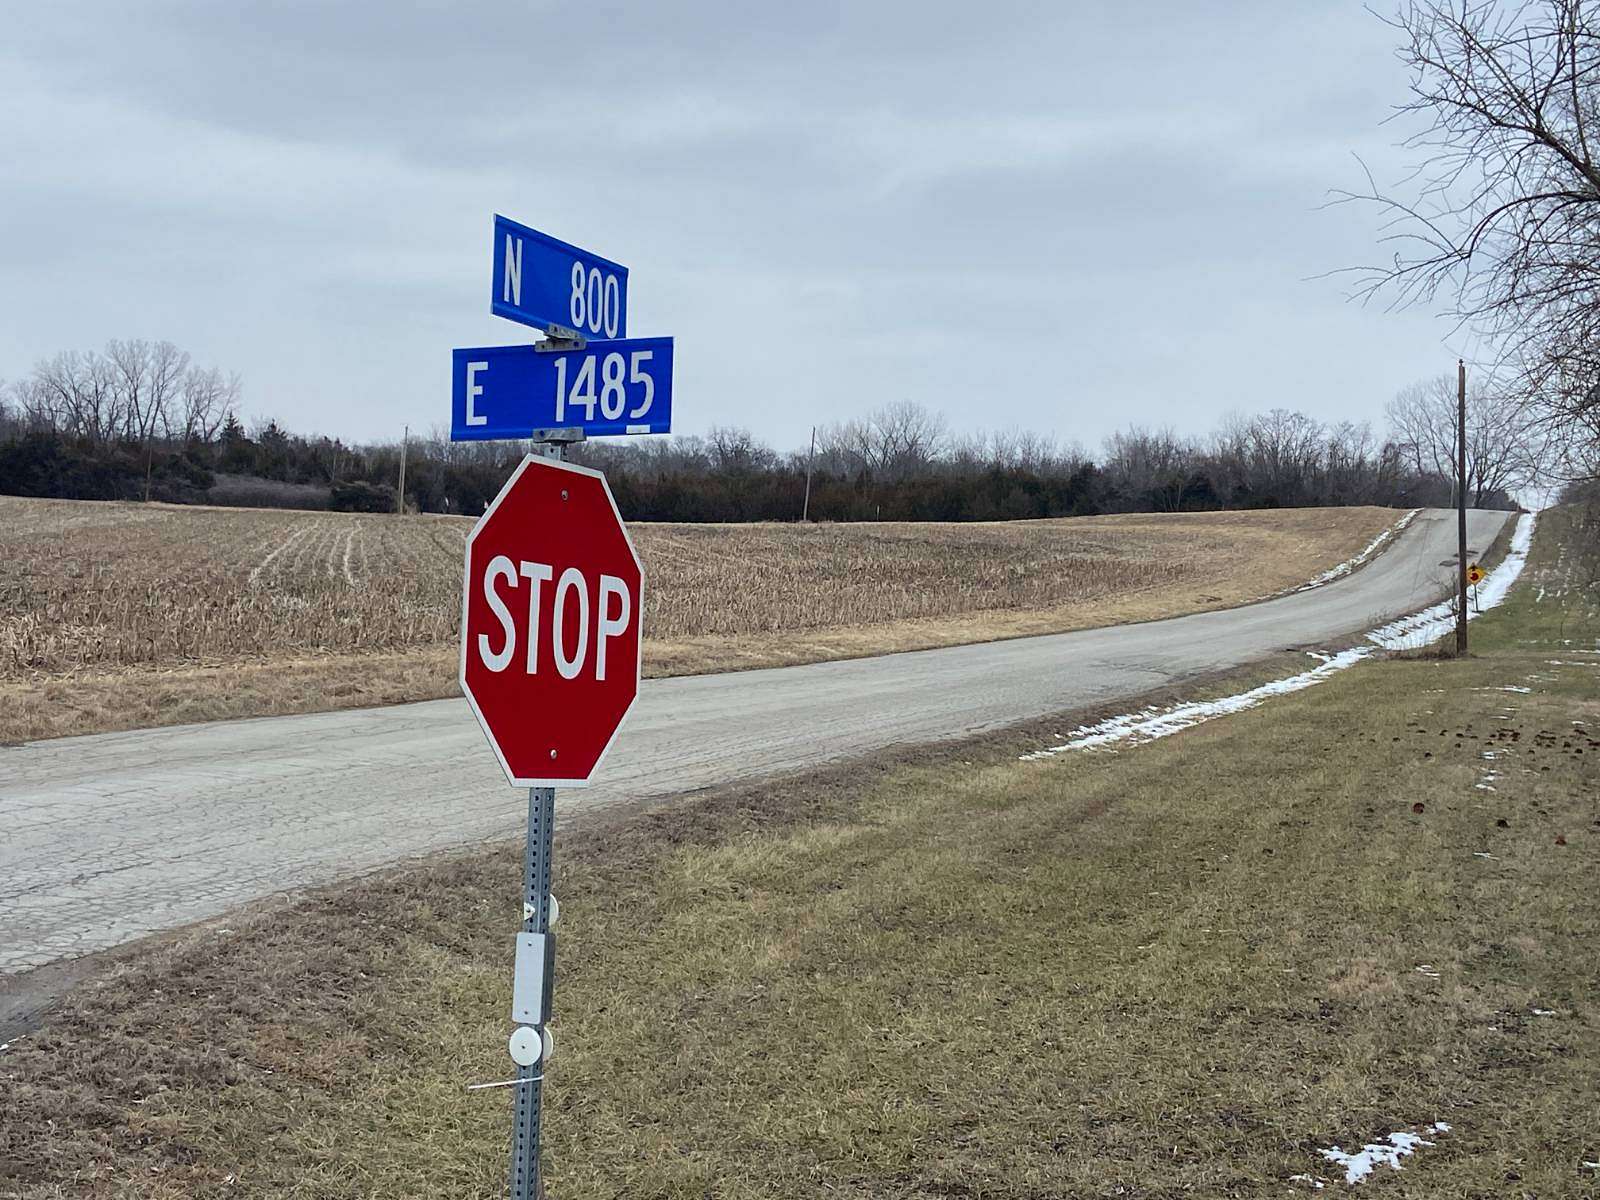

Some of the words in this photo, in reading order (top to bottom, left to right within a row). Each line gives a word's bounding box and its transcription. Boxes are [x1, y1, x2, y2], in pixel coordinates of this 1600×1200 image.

[503, 233, 523, 306] N
[570, 261, 619, 339] 800
[466, 361, 488, 426] E
[554, 350, 655, 423] 1485
[478, 555, 631, 681] STOP
